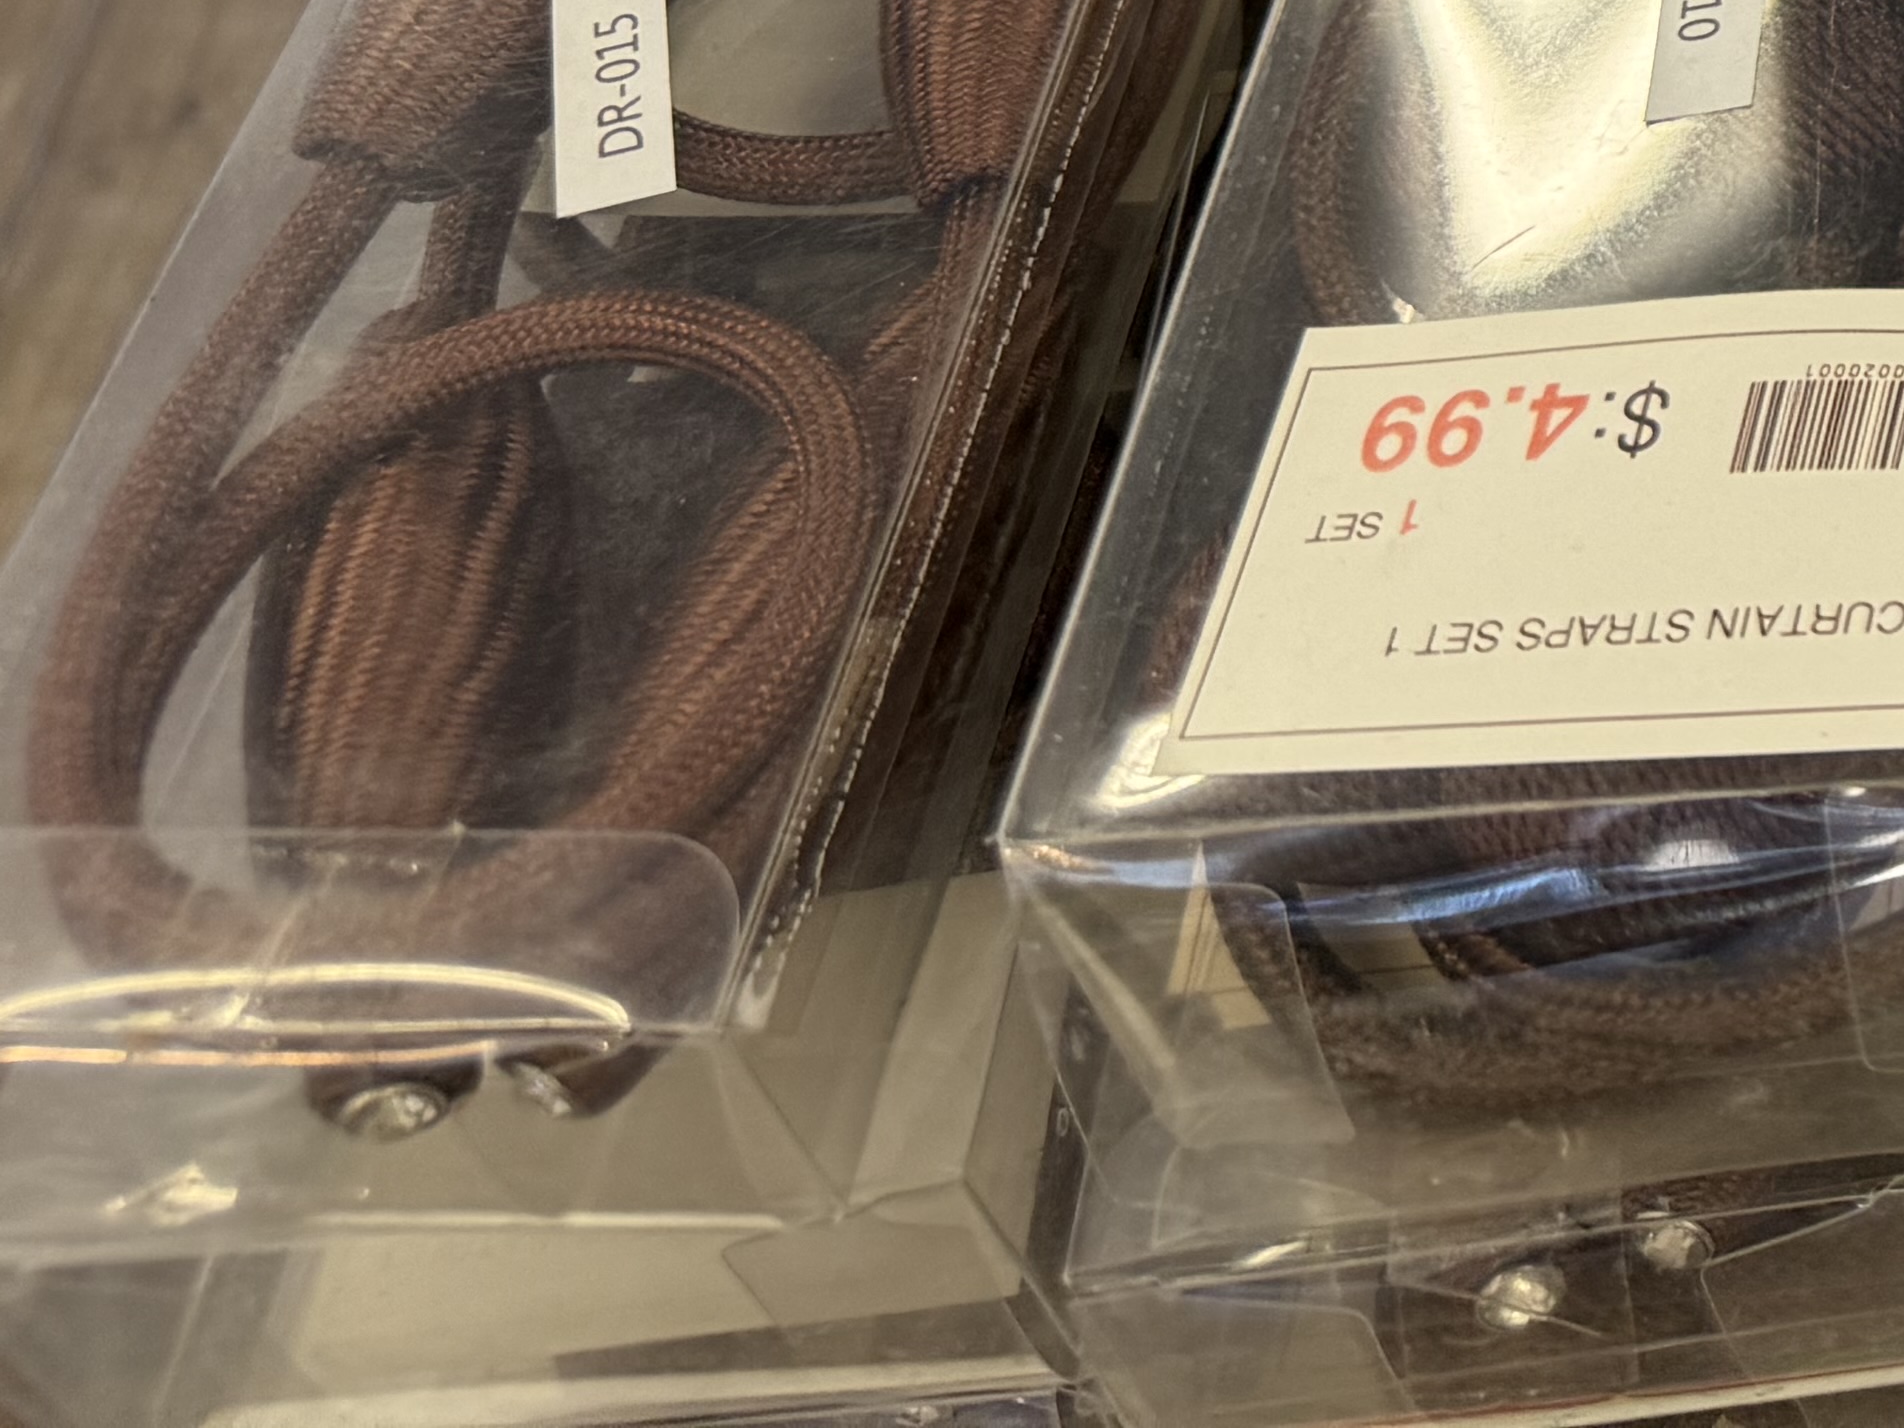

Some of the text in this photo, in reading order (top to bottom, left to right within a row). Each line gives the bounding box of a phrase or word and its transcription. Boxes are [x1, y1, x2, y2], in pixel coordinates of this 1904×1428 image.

[594, 13, 644, 158] DR-015
[1360, 380, 1671, 473] $:4.99
[1304, 499, 1420, 544] 1 SET
[1384, 626, 1400, 658] 1
[1413, 619, 1503, 657] SET
[1515, 609, 1695, 653] STRAPS
